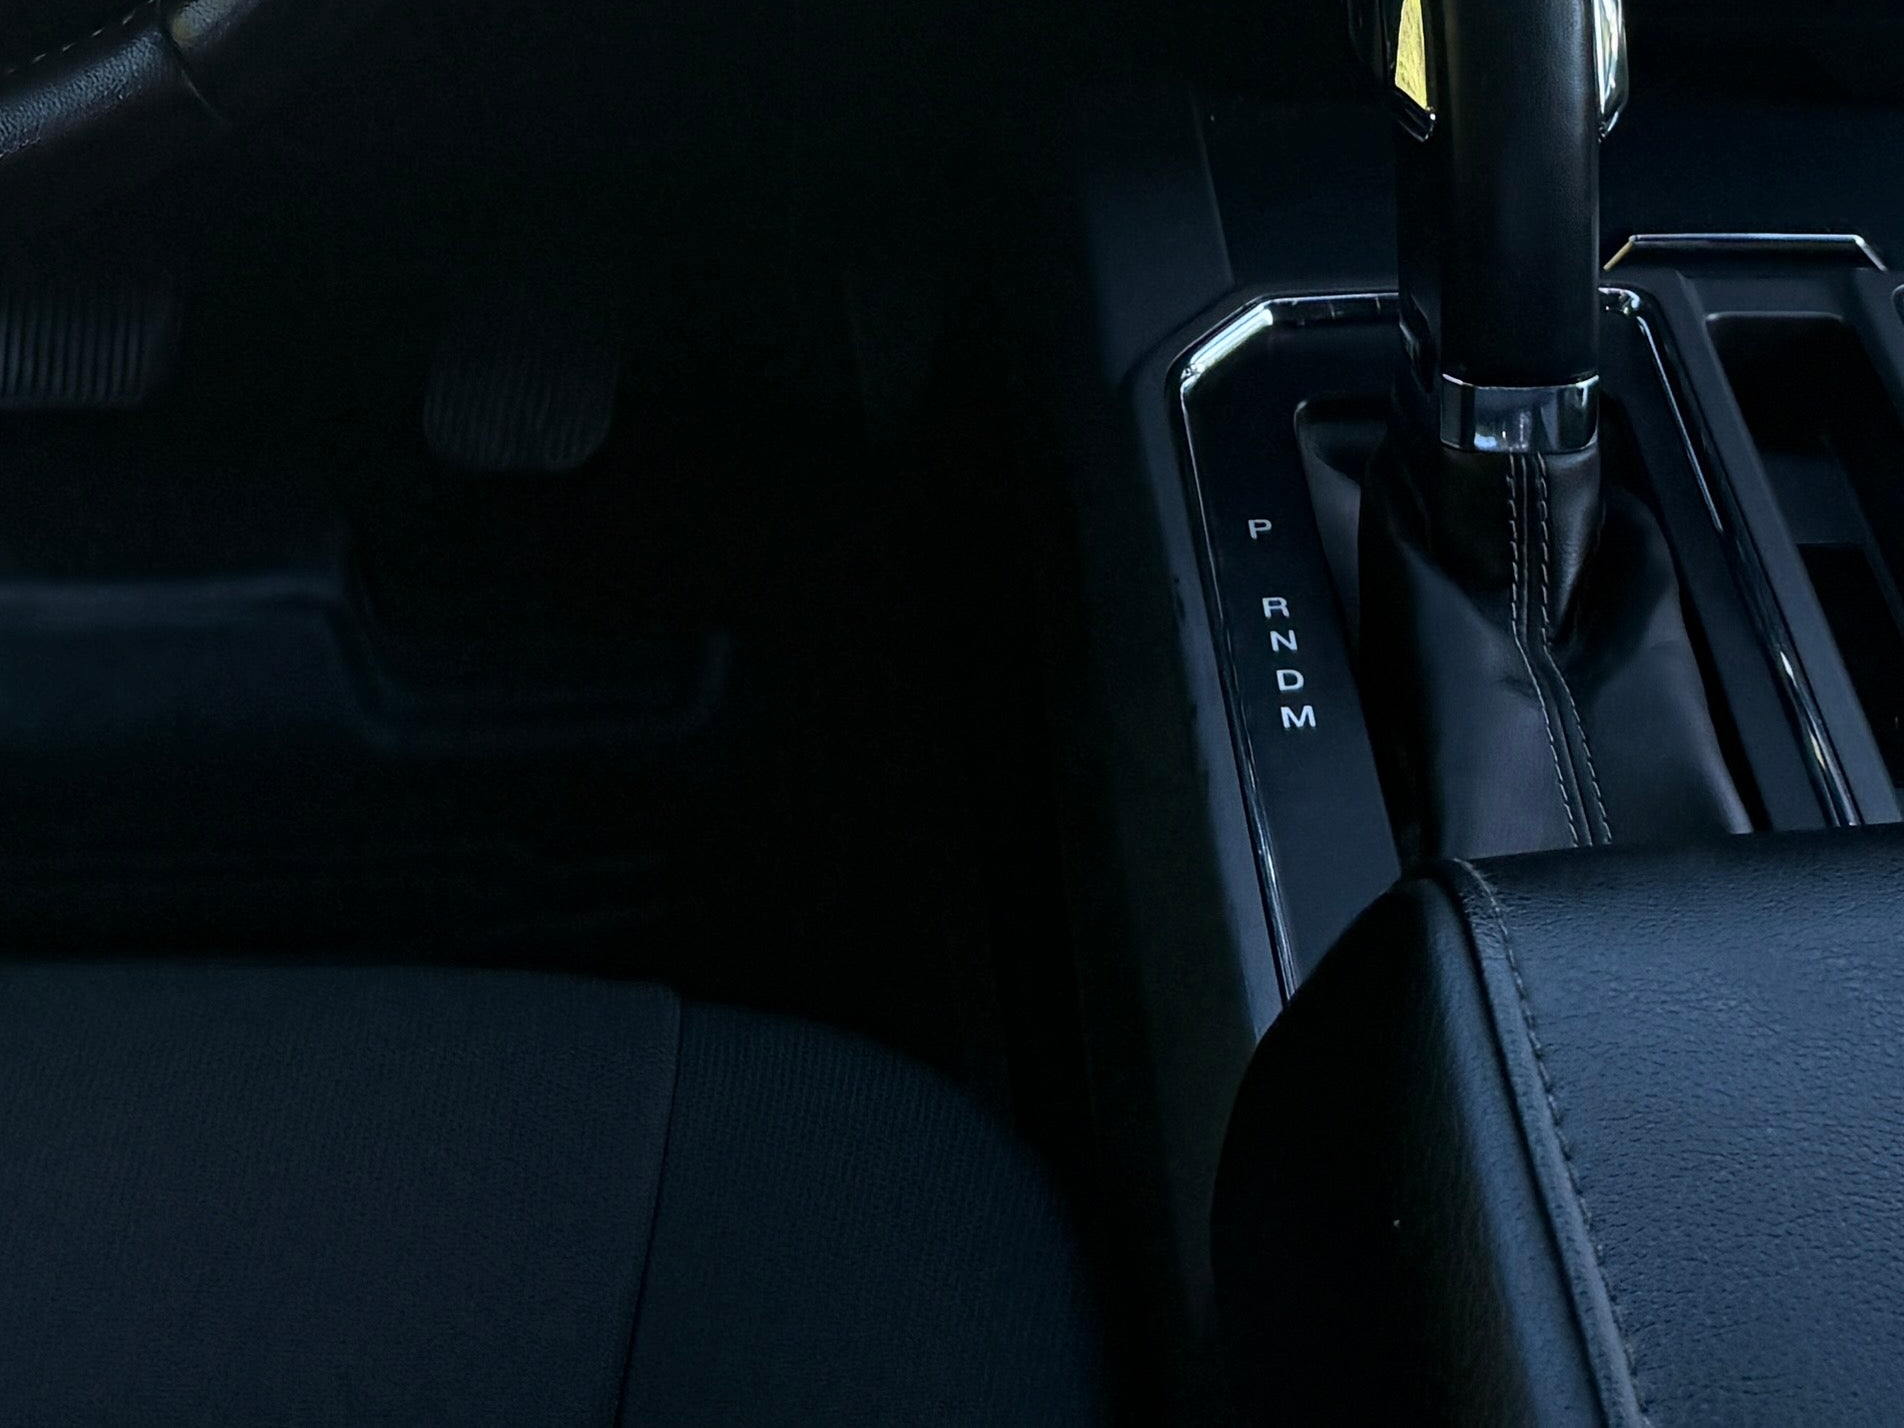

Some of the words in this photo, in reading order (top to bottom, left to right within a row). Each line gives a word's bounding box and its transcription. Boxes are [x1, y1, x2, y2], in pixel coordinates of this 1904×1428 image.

[1247, 518, 1273, 541] P
[1261, 596, 1291, 619] R
[1269, 629, 1299, 653] N
[1275, 668, 1305, 692] D
[1279, 704, 1317, 730] M
